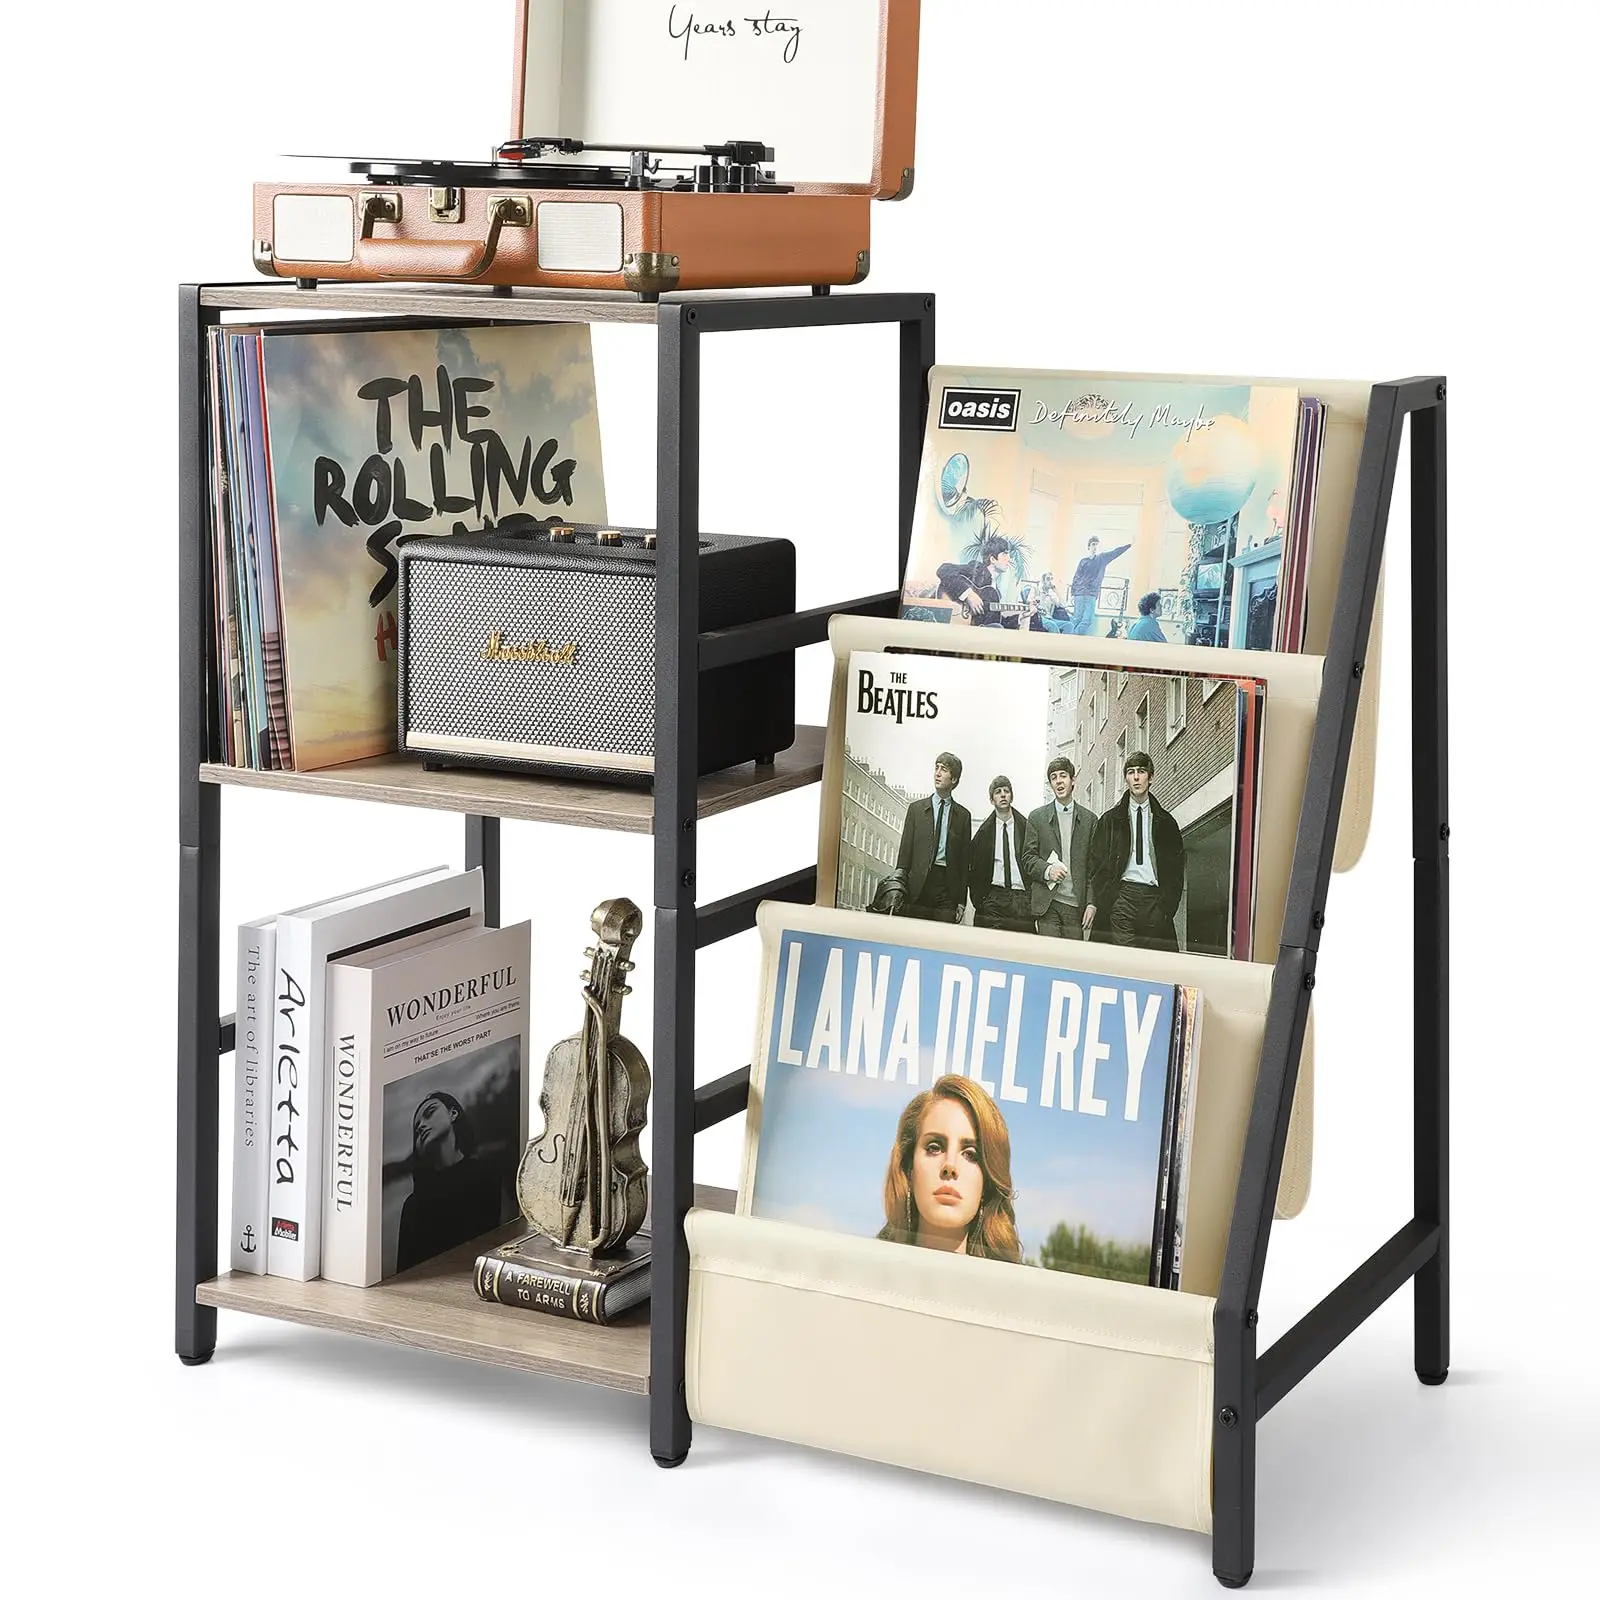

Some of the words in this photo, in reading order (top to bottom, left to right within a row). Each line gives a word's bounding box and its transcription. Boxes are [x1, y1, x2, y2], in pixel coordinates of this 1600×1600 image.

[669, 4, 736, 61] Years
[744, 9, 803, 63] stay
[357, 364, 496, 454] THE
[947, 397, 1012, 420] oasis
[1028, 400, 1144, 439] Definitely
[1149, 402, 1216, 443] Maybe
[314, 428, 578, 528] ROLLING
[857, 669, 939, 724] BEATLES
[890, 671, 908, 684] THE
[247, 946, 260, 985] The
[246, 993, 256, 1021] art
[387, 966, 517, 1028] WONDERFUL
[476, 1010, 491, 1020] Where
[491, 1008, 500, 1016] you
[246, 1030, 258, 1055] of
[402, 1041, 409, 1049] my
[410, 1037, 420, 1046] way
[420, 1034, 425, 1042] to
[414, 1048, 439, 1064] THAT'SE
[440, 1044, 452, 1054] THE
[453, 1035, 475, 1050] WORST
[476, 1029, 492, 1041] PART
[777, 941, 921, 1087] LANA
[931, 963, 1028, 1104] DEL
[1040, 979, 1163, 1122] REY
[245, 1059, 259, 1147] libraries
[337, 1034, 355, 1213] WONDERFUL
[505, 1271, 513, 1282] A
[516, 1273, 571, 1296] FAREWELL
[517, 1288, 530, 1301] TO
[535, 1292, 565, 1309] ARMS
